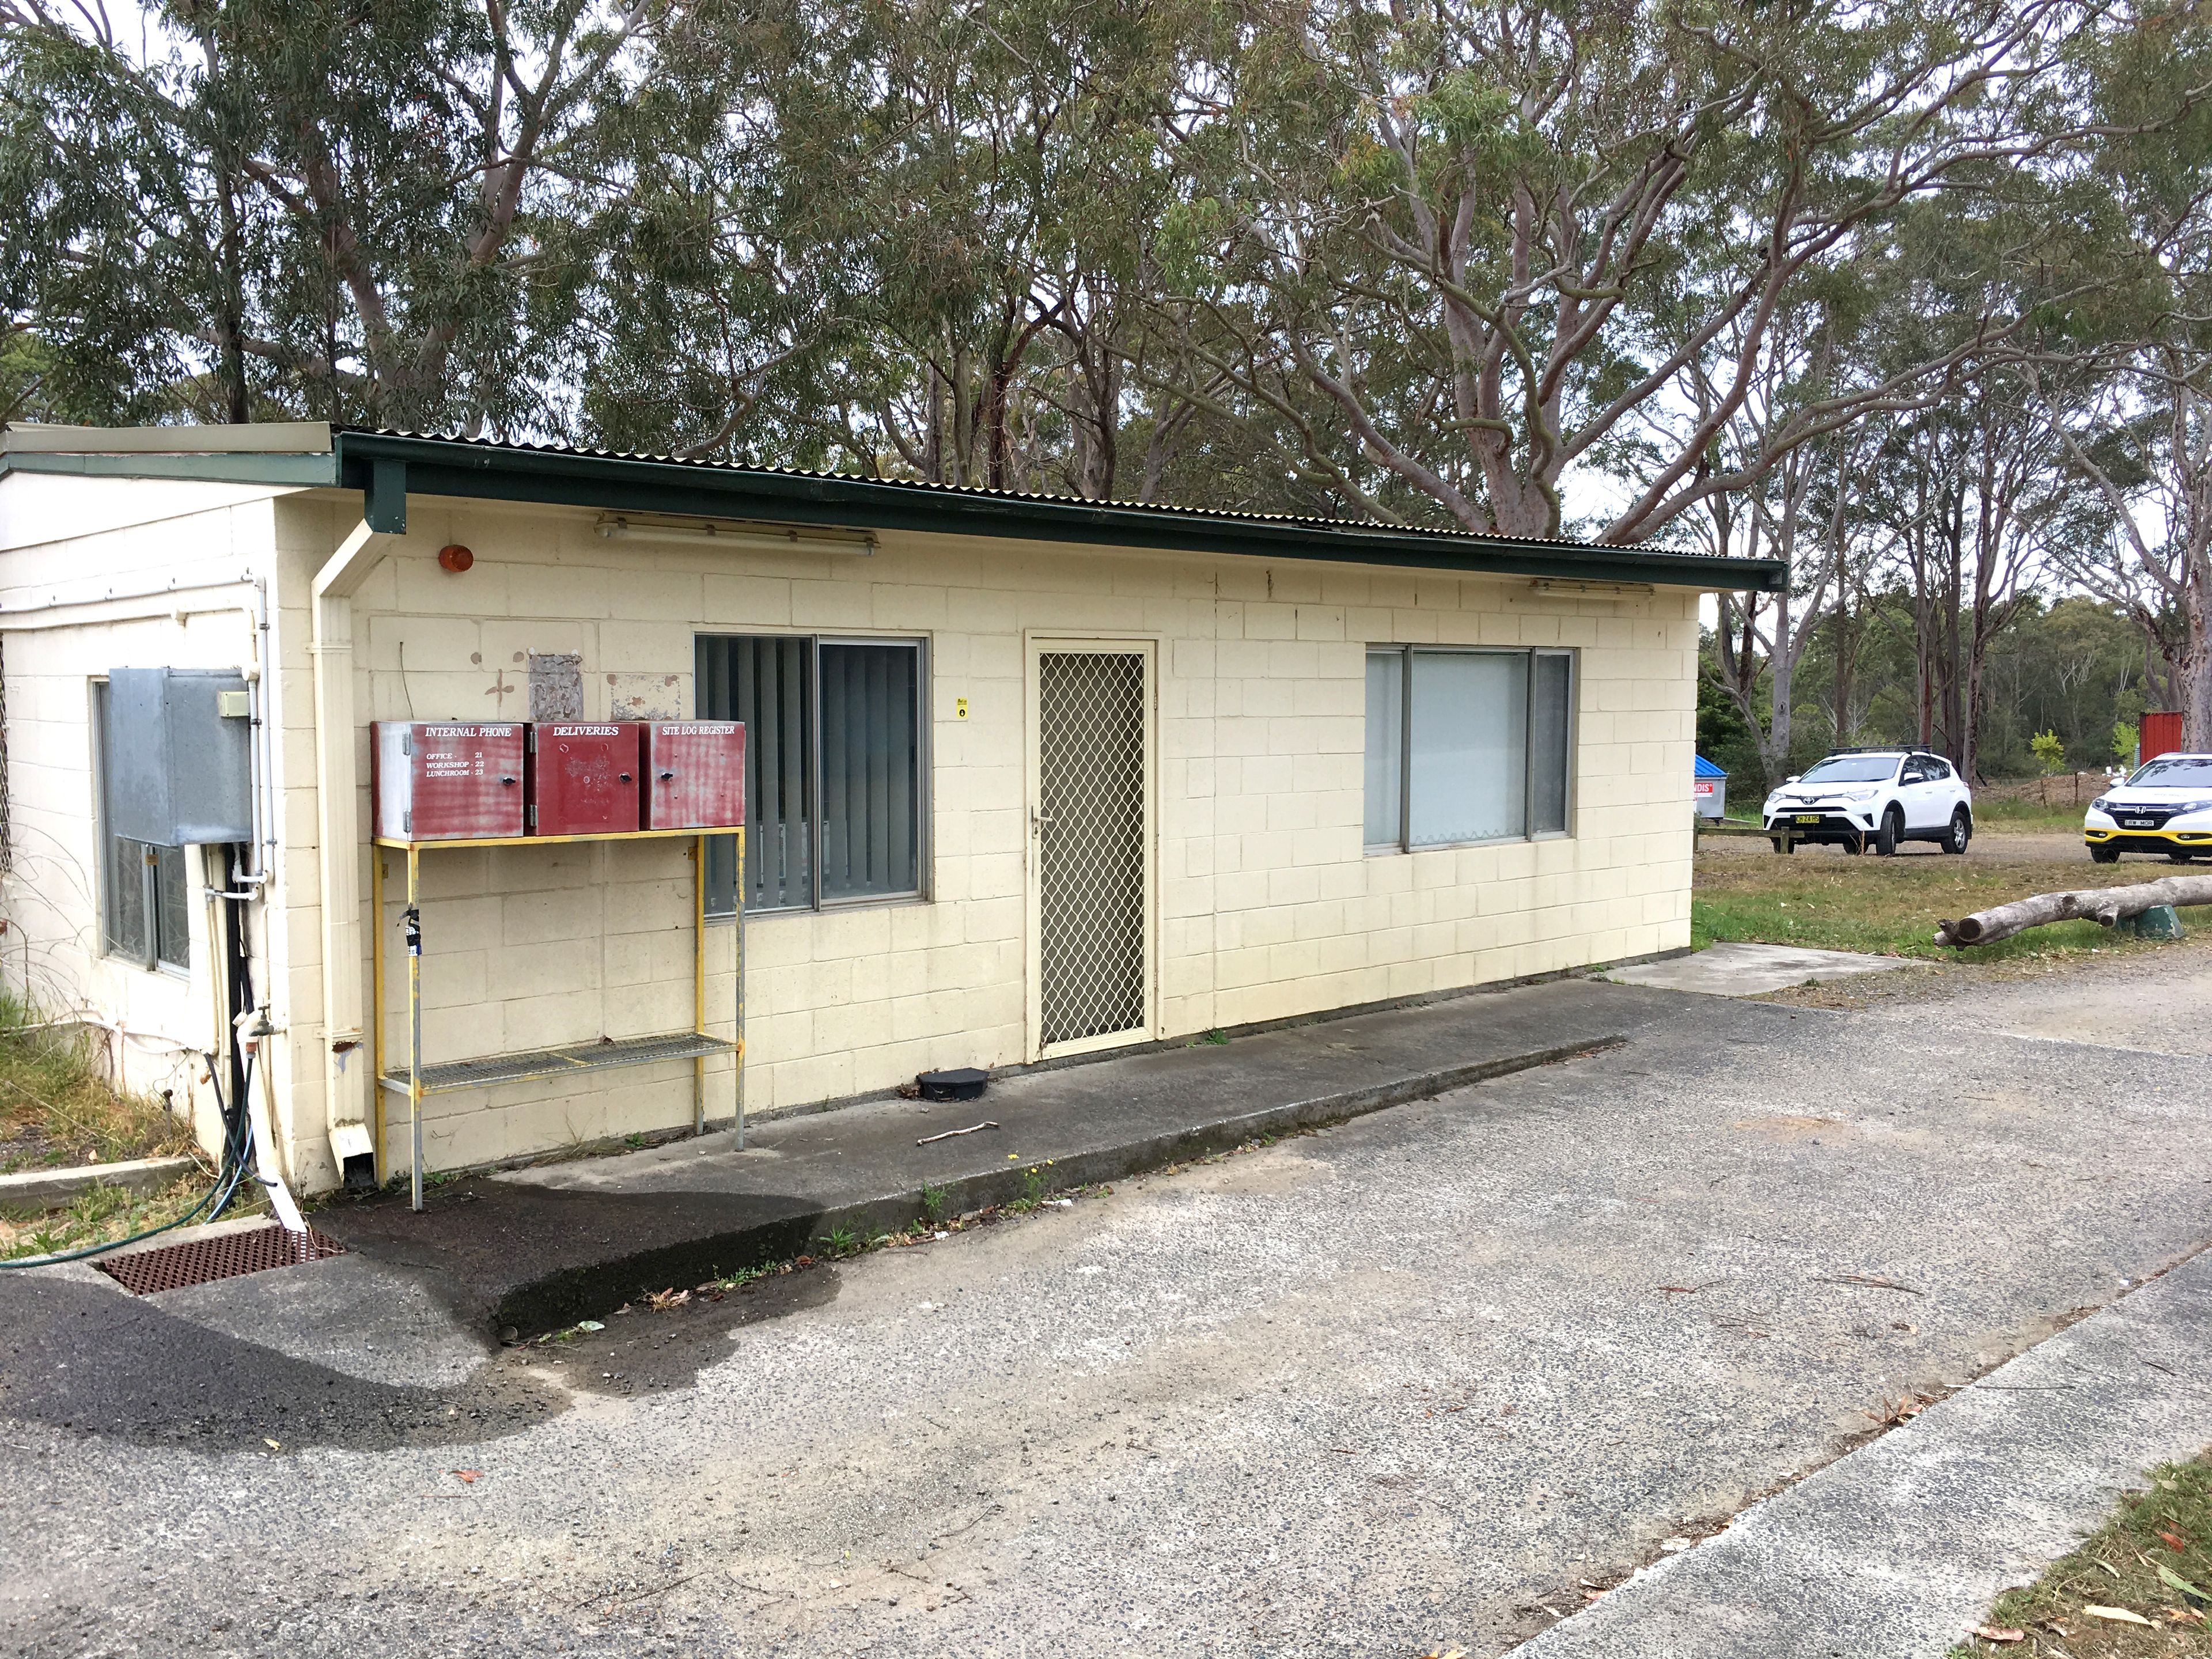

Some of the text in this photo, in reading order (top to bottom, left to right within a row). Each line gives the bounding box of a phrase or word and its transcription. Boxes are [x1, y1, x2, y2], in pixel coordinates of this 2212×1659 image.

[425, 727, 512, 737] INTERNAL PHONE
[553, 726, 619, 736] DELIVERIES
[662, 725, 735, 735] SITE LOG REGISTER
